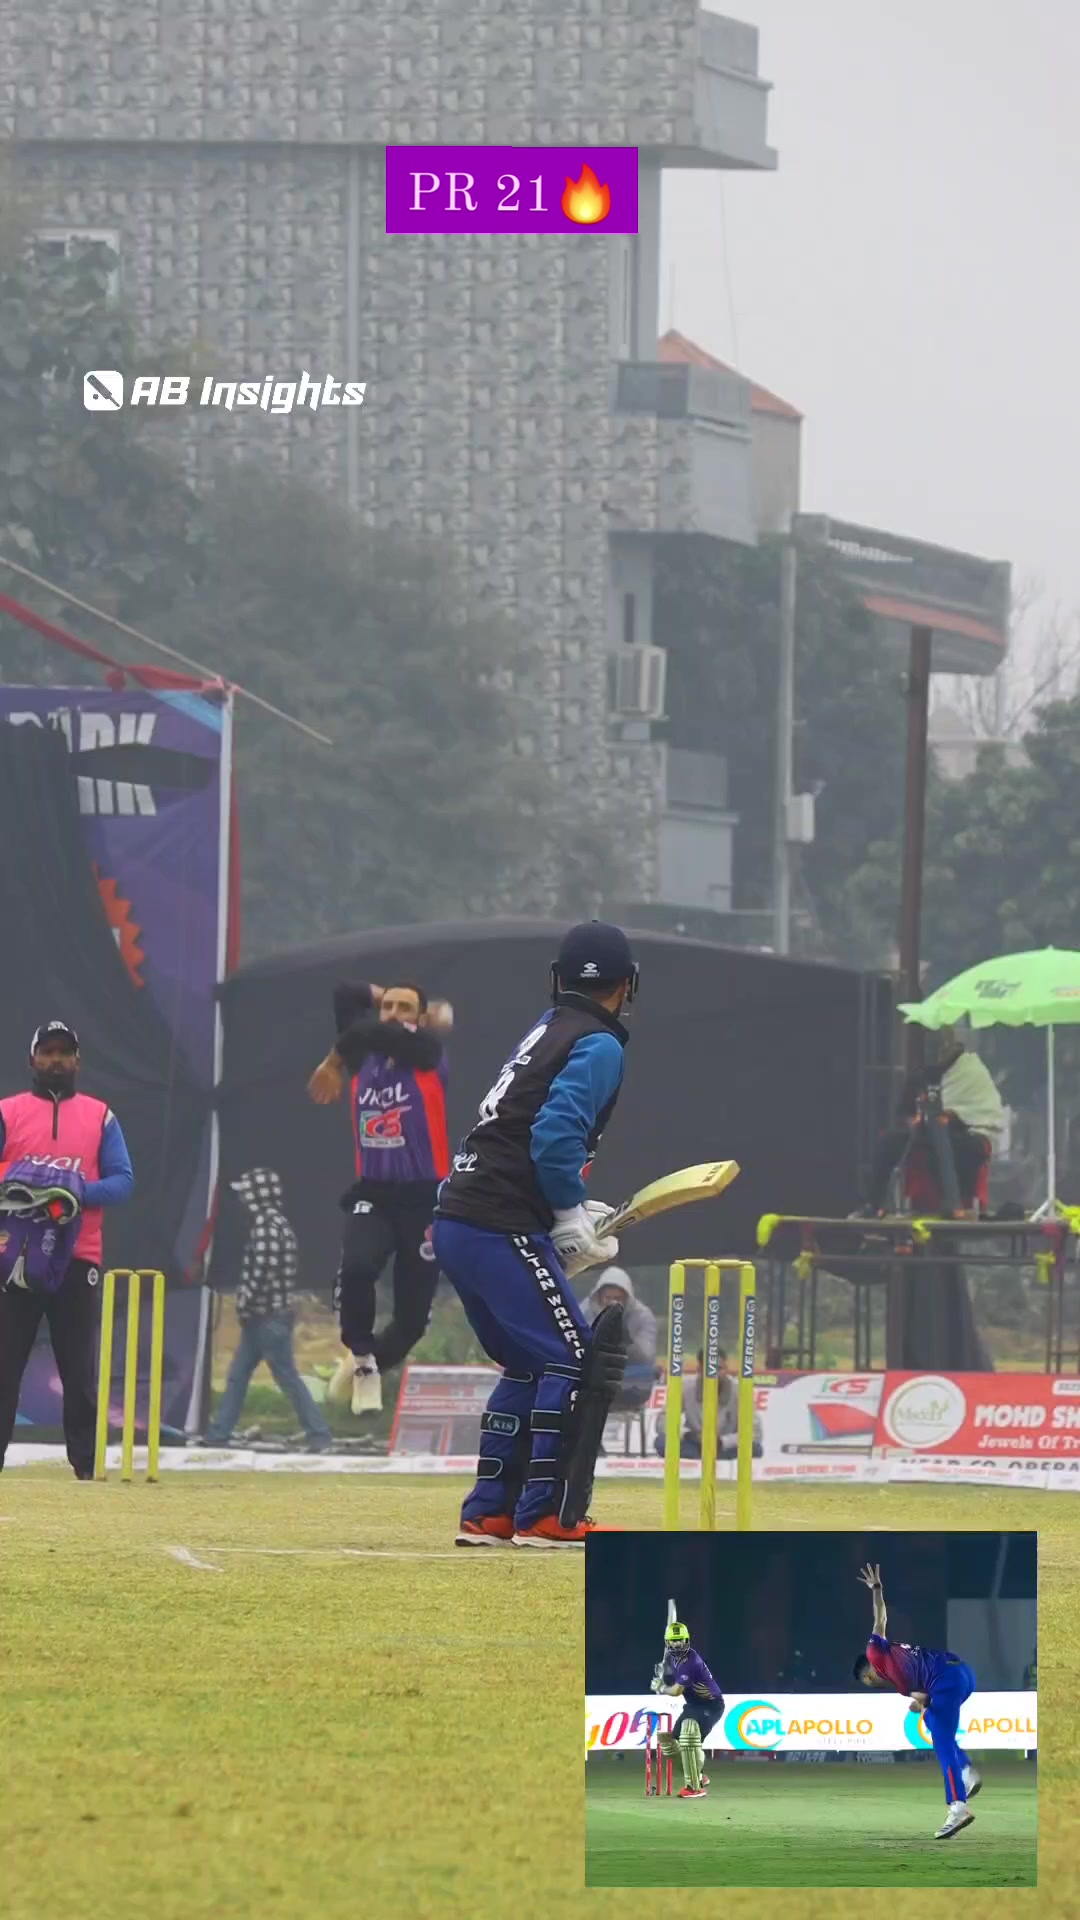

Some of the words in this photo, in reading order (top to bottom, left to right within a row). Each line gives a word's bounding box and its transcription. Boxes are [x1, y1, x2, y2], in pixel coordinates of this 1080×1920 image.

[512, 1233, 556, 1291] ULTAN
[672, 1311, 683, 1375] VERSON
[708, 1314, 719, 1376] VERSON
[743, 1314, 754, 1376] VERSON
[974, 1403, 1046, 1428] MOHD
[978, 1434, 1033, 1449] Jewels
[746, 1718, 786, 1735] APL
[787, 1718, 873, 1735] APOLLO
